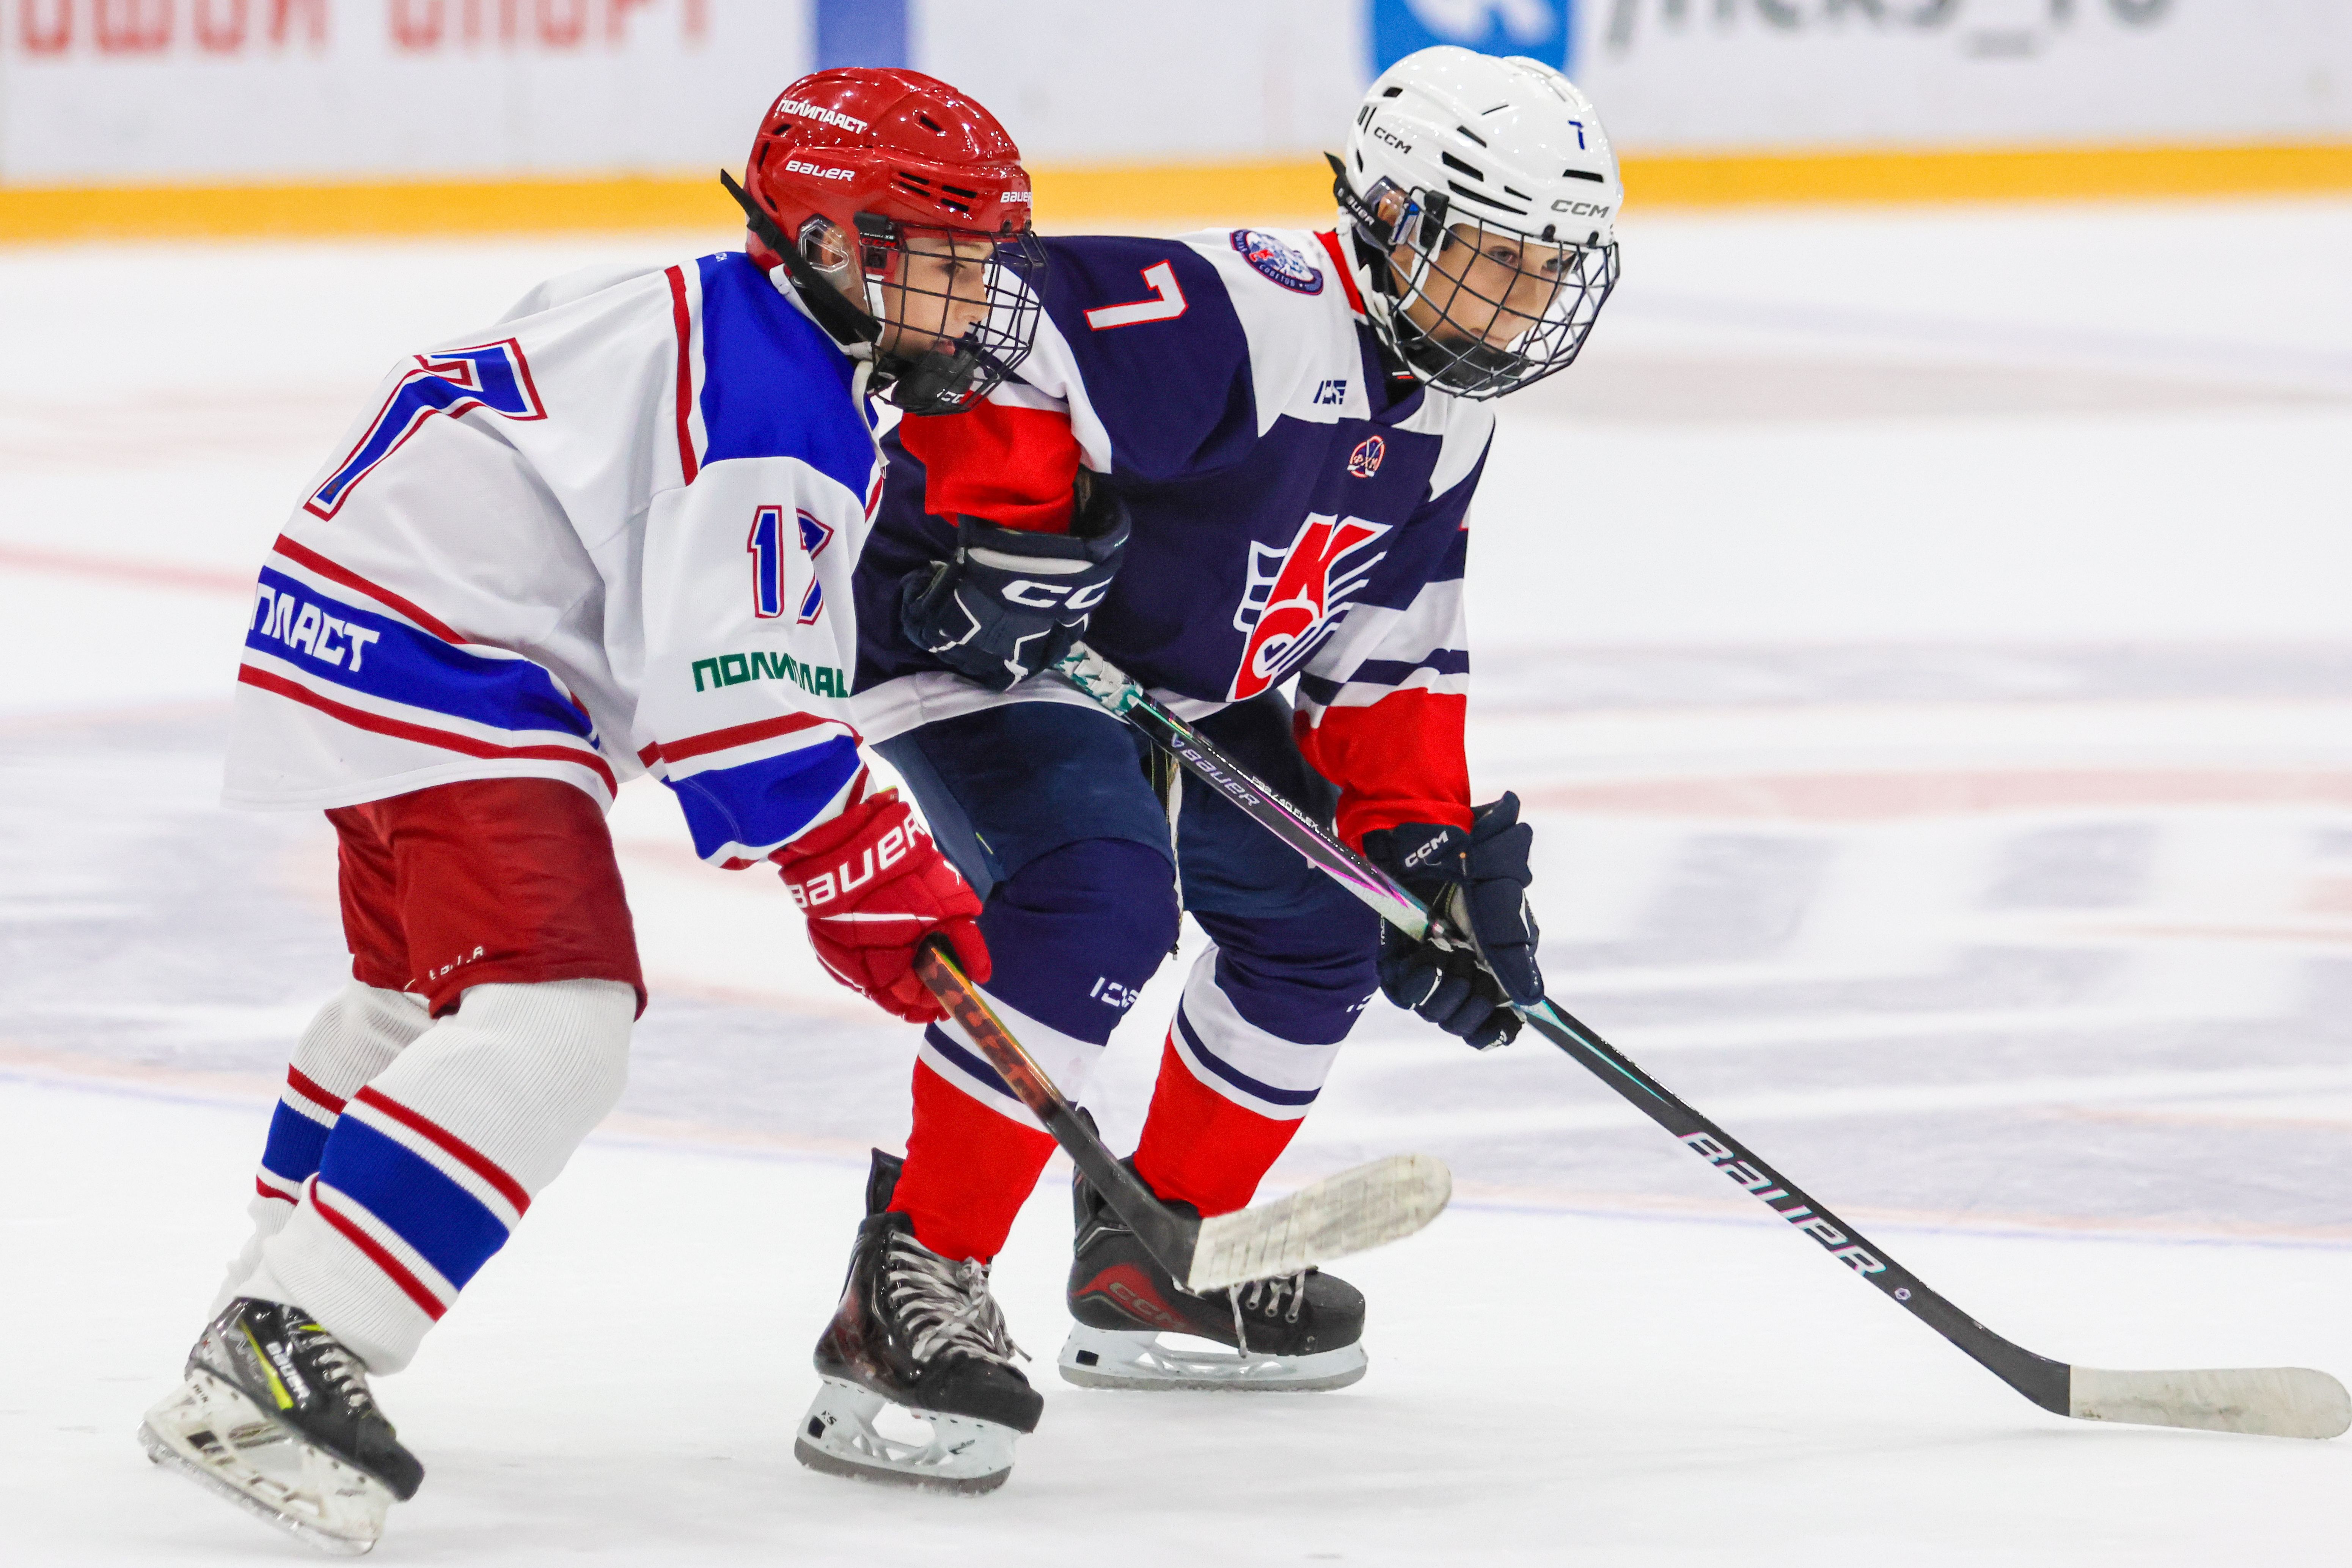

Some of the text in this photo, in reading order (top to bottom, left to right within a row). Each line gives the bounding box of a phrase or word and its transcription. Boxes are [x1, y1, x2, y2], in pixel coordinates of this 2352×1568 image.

[1374, 126, 1412, 154] CCM
[1568, 120, 1585, 150] 7
[785, 160, 855, 182] BAUER
[1551, 199, 1609, 218] CCM
[1084, 259, 1188, 330] 7
[747, 505, 834, 625] 17
[1180, 748, 1260, 806] BAUER
[786, 811, 925, 908] BAUER
[1405, 830, 1448, 868] CCM
